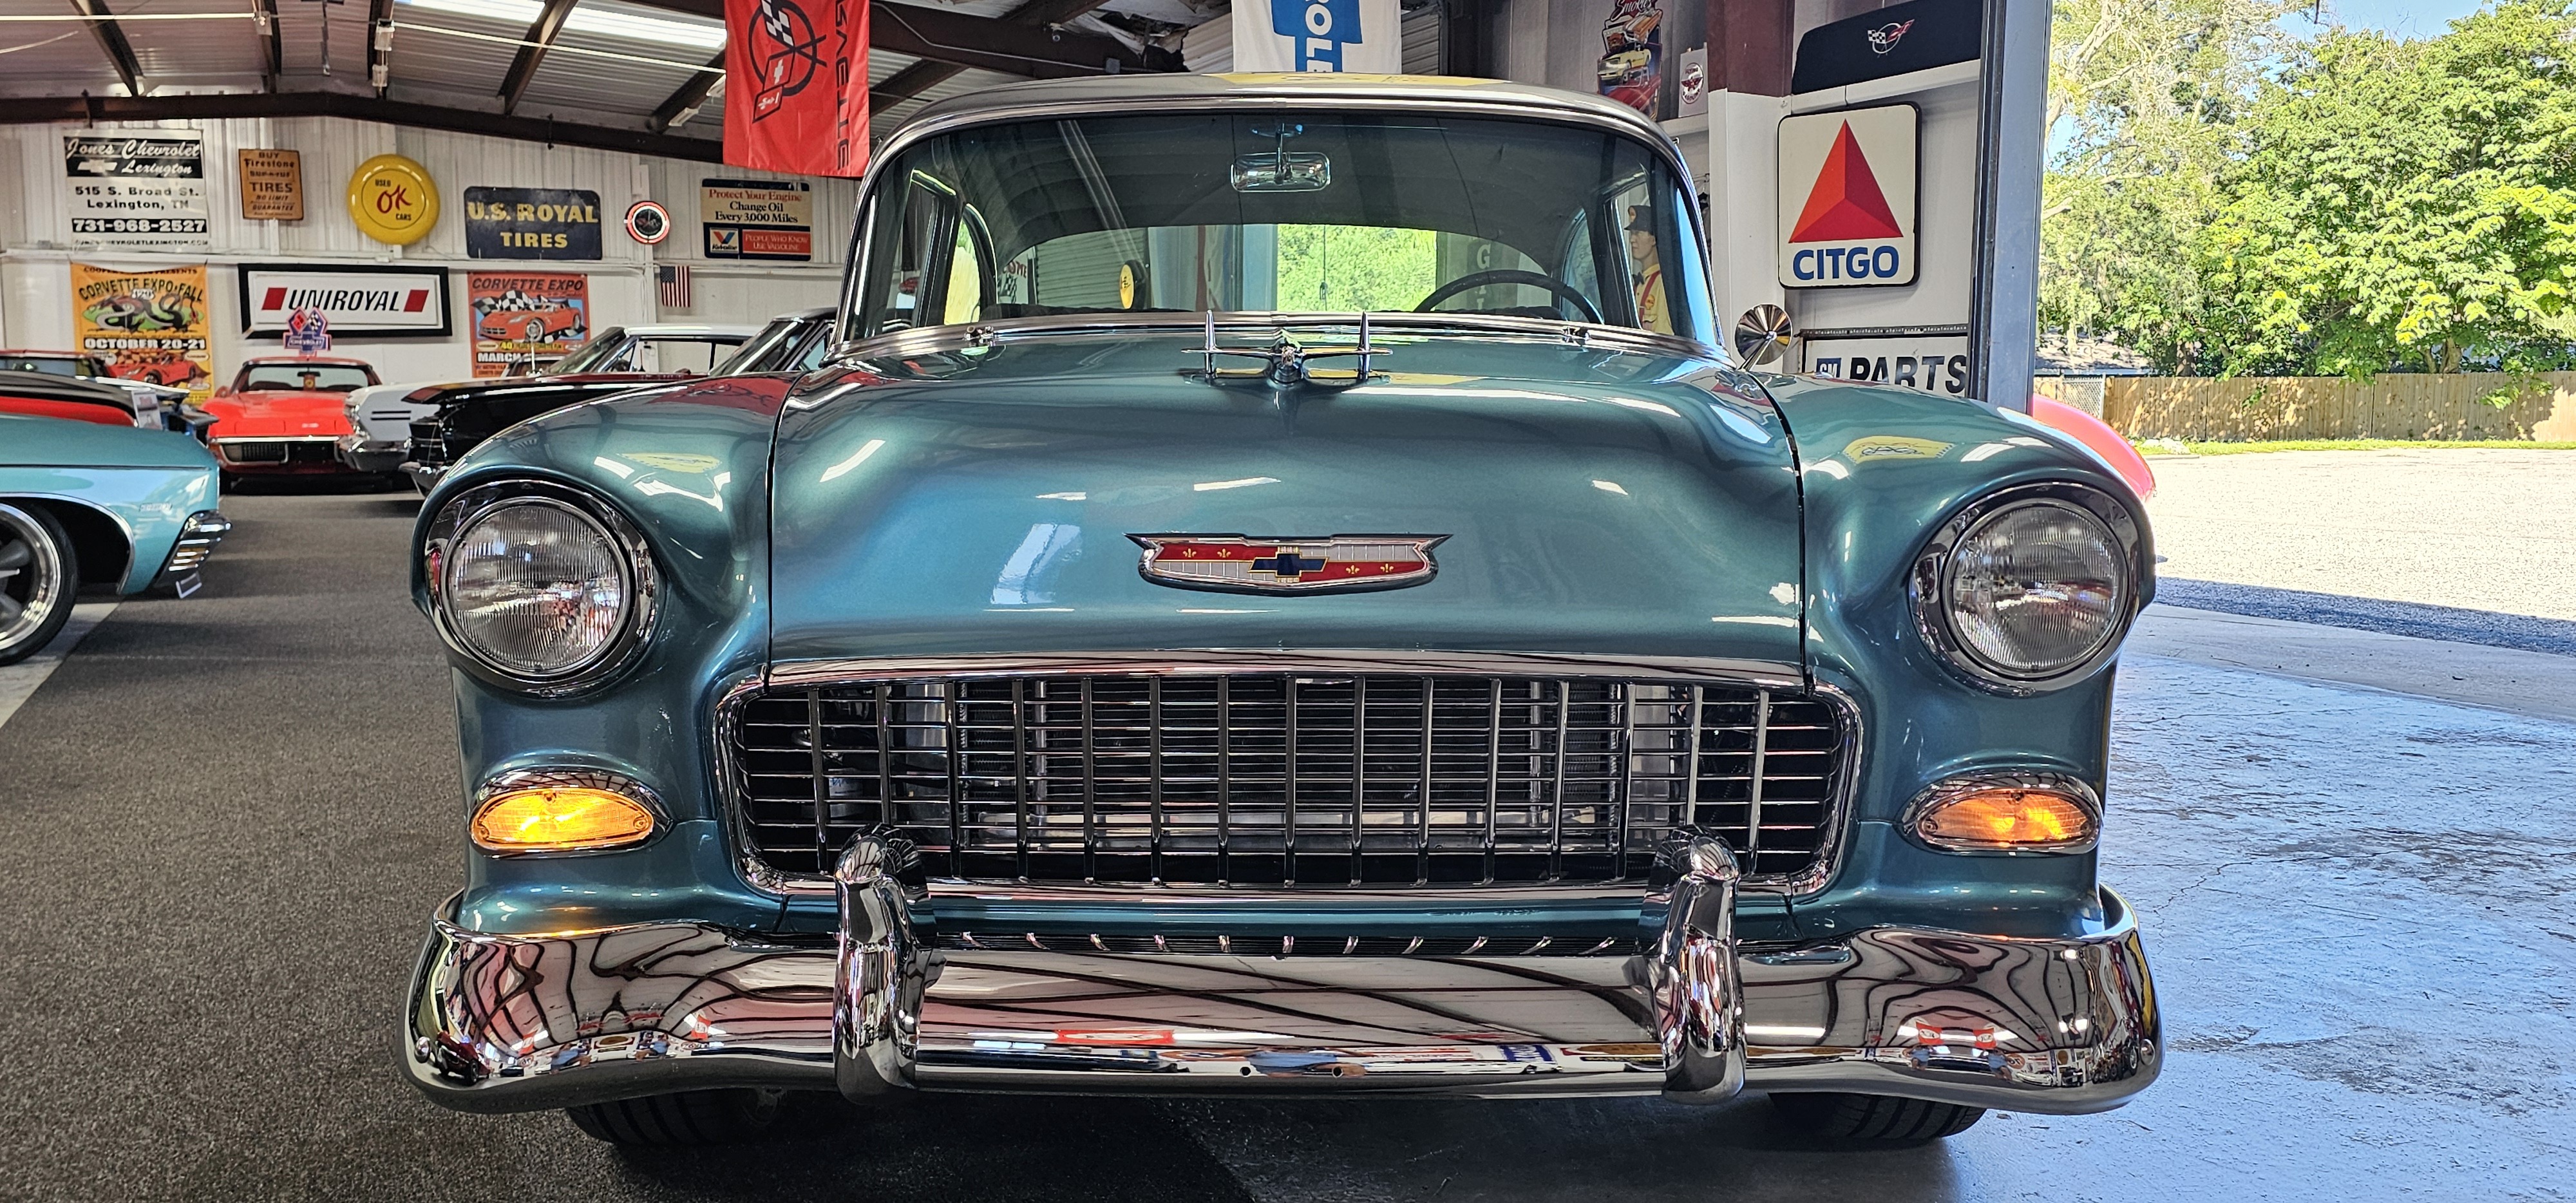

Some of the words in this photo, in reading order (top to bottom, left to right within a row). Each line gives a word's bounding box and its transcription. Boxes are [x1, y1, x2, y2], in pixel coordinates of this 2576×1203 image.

[66, 138, 115, 159] Jones
[121, 139, 200, 159] Chevrolet
[121, 160, 193, 176] Lexington
[249, 182, 292, 193] TIRES
[375, 179, 391, 187] USED
[75, 186, 100, 196] 515
[108, 186, 122, 196] S.
[129, 186, 171, 196] Broad
[178, 187, 199, 196] St.
[709, 189, 743, 199] Protect
[745, 190, 766, 200] Your
[768, 191, 802, 202] Engine
[87, 199, 165, 211] Lexington,
[171, 200, 189, 209] TN
[377, 184, 413, 214] OK
[468, 202, 511, 221] U.S.
[517, 204, 599, 223] ROYAL
[730, 201, 767, 213] Change
[768, 202, 784, 212] Oil
[715, 211, 743, 223] Every
[744, 213, 770, 222] 3,000
[772, 213, 799, 223] Miles
[73, 219, 205, 232] 731-968-2527
[500, 232, 568, 248] TIRES
[1793, 245, 1899, 281] CITGO
[79, 278, 139, 301] CORVETTE
[472, 278, 545, 290] CORVETTE
[547, 279, 584, 290] EXPO
[288, 289, 399, 311] UNIROYAL
[84, 337, 158, 349] OCTOBER
[161, 338, 205, 350] 20-21
[478, 352, 522, 362] MARCH
[1850, 354, 1967, 394] PARTS
